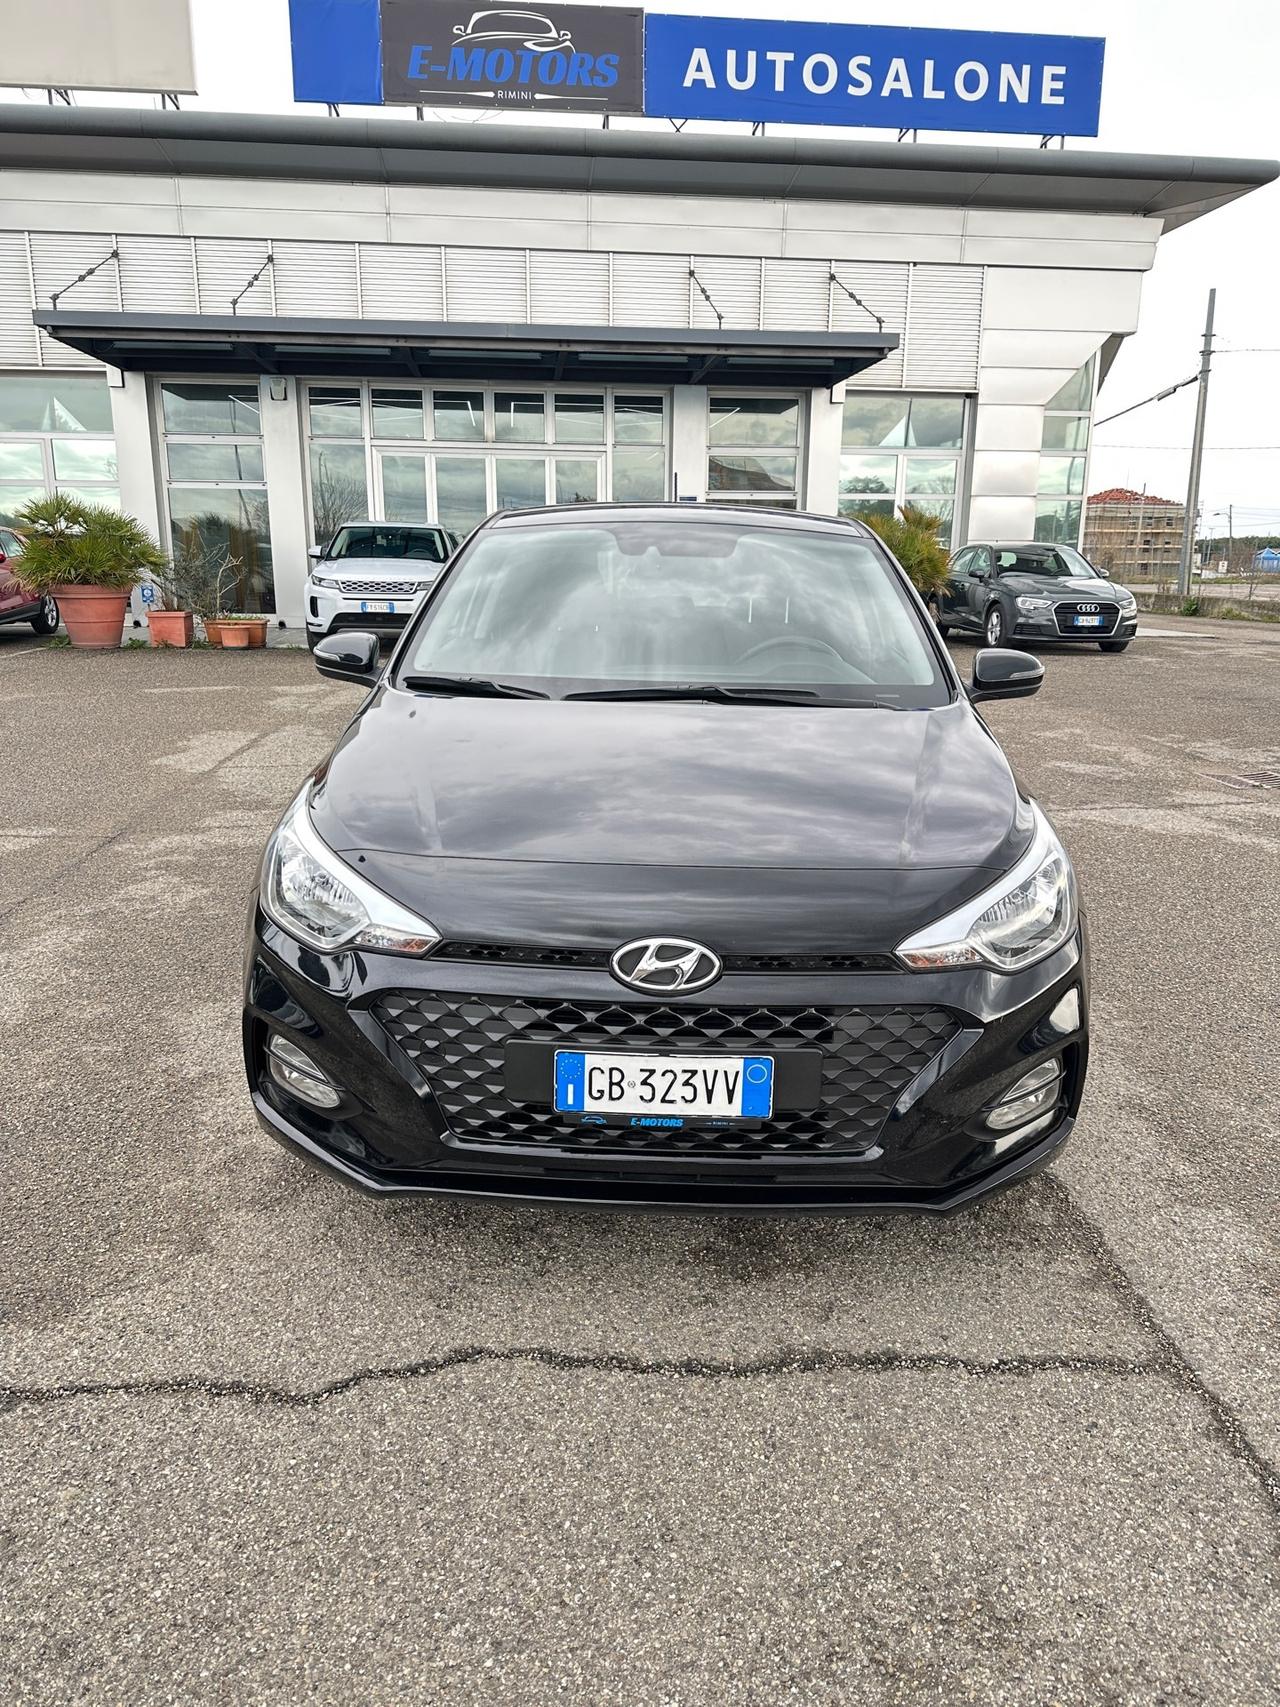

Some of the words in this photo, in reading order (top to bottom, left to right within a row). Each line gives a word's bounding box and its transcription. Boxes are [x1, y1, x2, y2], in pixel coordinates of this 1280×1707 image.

[407, 44, 620, 87] E-MOTORS
[682, 47, 1067, 105] AUTOSALONE
[497, 90, 533, 100] RIMINI
[588, 1066, 626, 1101] GB
[638, 1067, 740, 1105] 323VV
[630, 1117, 684, 1127] E-MOTORS
